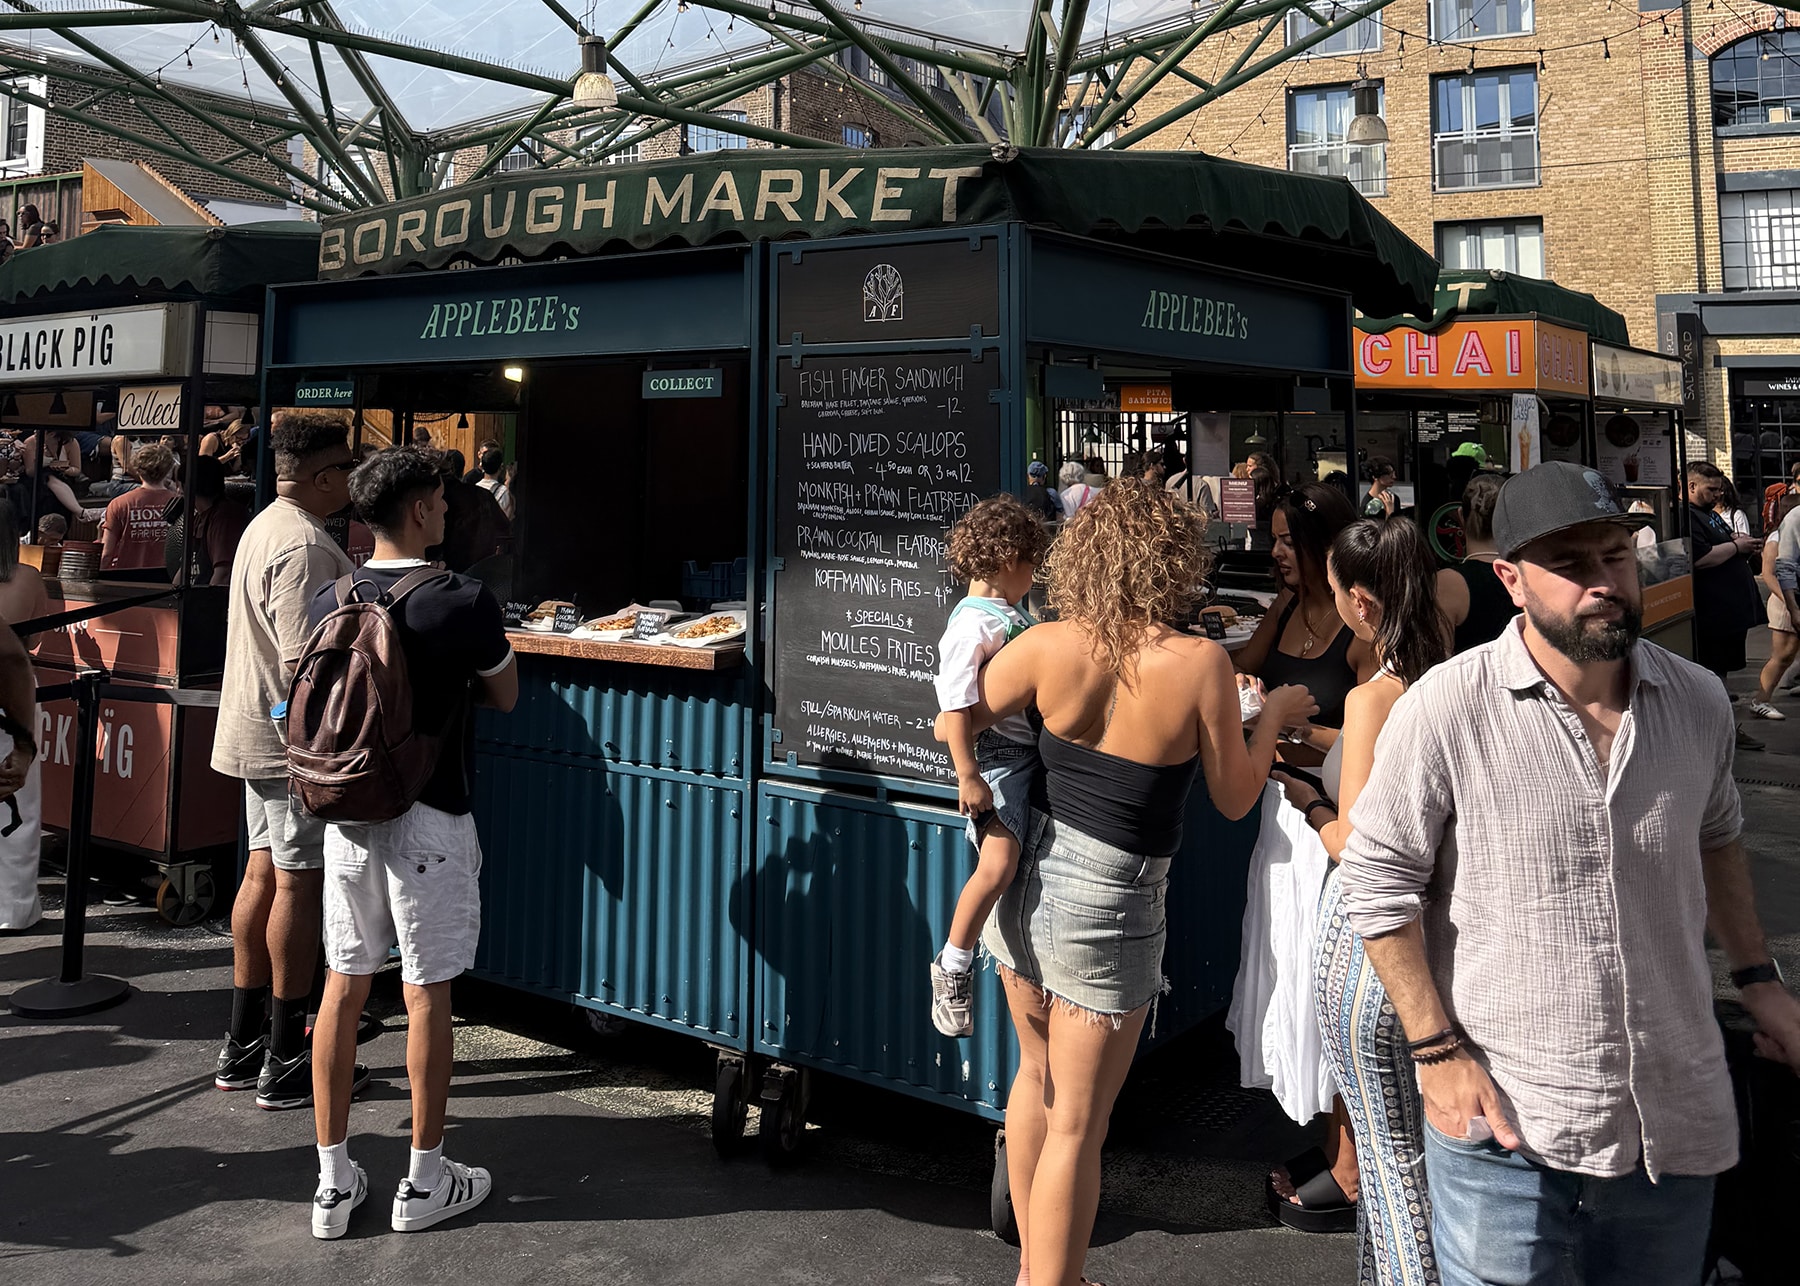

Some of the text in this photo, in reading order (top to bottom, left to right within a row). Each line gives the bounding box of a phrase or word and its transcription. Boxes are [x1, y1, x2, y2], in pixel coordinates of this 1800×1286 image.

[320, 166, 981, 272] BOROUGH MARKET
[420, 294, 580, 340] APPLEBEE's
[1140, 289, 1249, 341] APPLEBEE's
[72, 315, 114, 366] PÏG
[1360, 330, 1521, 376] CHAI
[1540, 332, 1583, 385] CHAI
[1682, 331, 1695, 401] SALT YARD
[297, 388, 353, 399] ORDER here
[650, 377, 714, 391] COLLECT
[800, 364, 964, 400] FISH FINGER SANDWICH
[119, 391, 182, 428] Collect
[1514, 396, 1536, 409] MANGO
[802, 431, 967, 459] HAND-DIVED SCALLOPS
[897, 466, 913, 475] EACH
[917, 465, 934, 485] OR
[936, 464, 944, 480] 3
[798, 481, 854, 507] MONKFISH
[864, 484, 901, 514] PRAWN
[130, 509, 165, 521] HON
[130, 521, 167, 529] TRUFF
[797, 525, 949, 565] PRAWN COCKTAIL FLATBREA
[890, 577, 921, 600] FRIES
[854, 609, 905, 628] SPECIALS
[821, 630, 935, 668] MOULES FRITES
[872, 711, 902, 729] WATER
[102, 708, 133, 778] ÏG
[851, 733, 891, 751] ALLERGENS
[897, 740, 949, 765] INTOLERANCES
[925, 763, 934, 773] OF
[946, 768, 958, 779] TEA
